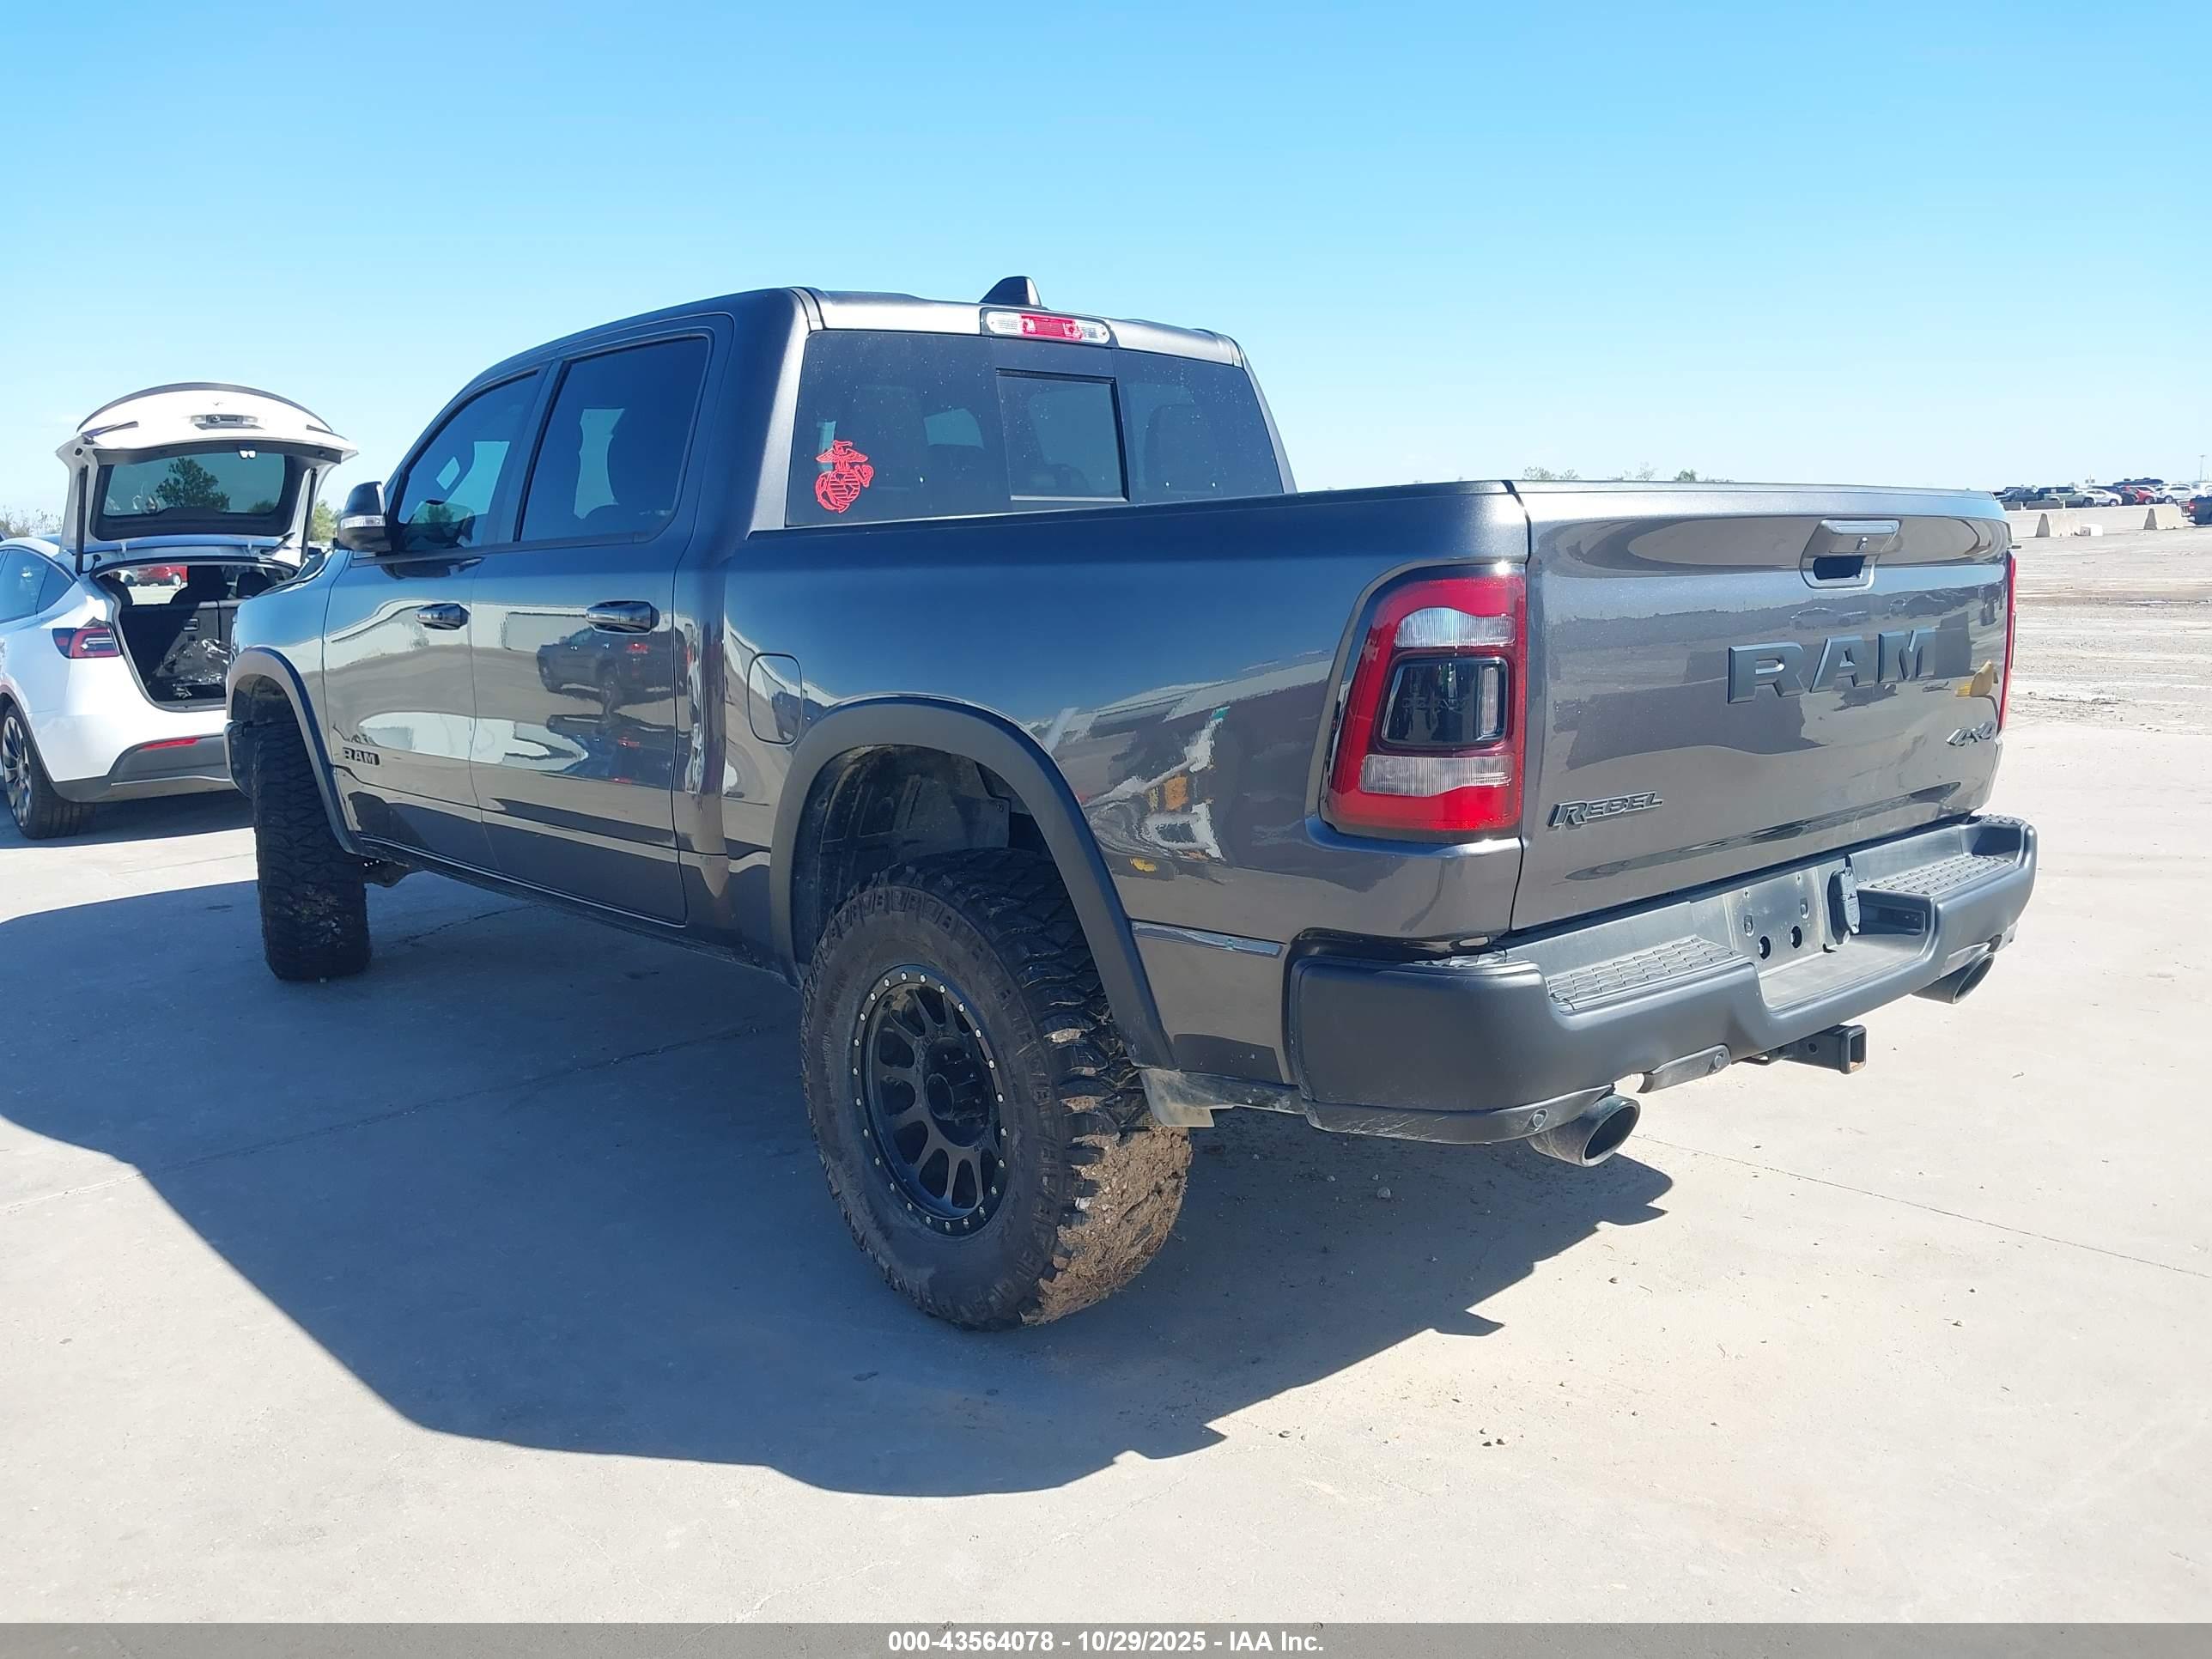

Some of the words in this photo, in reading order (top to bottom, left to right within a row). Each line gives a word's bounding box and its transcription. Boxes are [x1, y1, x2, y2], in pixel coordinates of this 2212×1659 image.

[1728, 629, 1936, 704] RAM
[342, 746, 380, 766] RAM
[1547, 791, 1663, 827] REBEL
